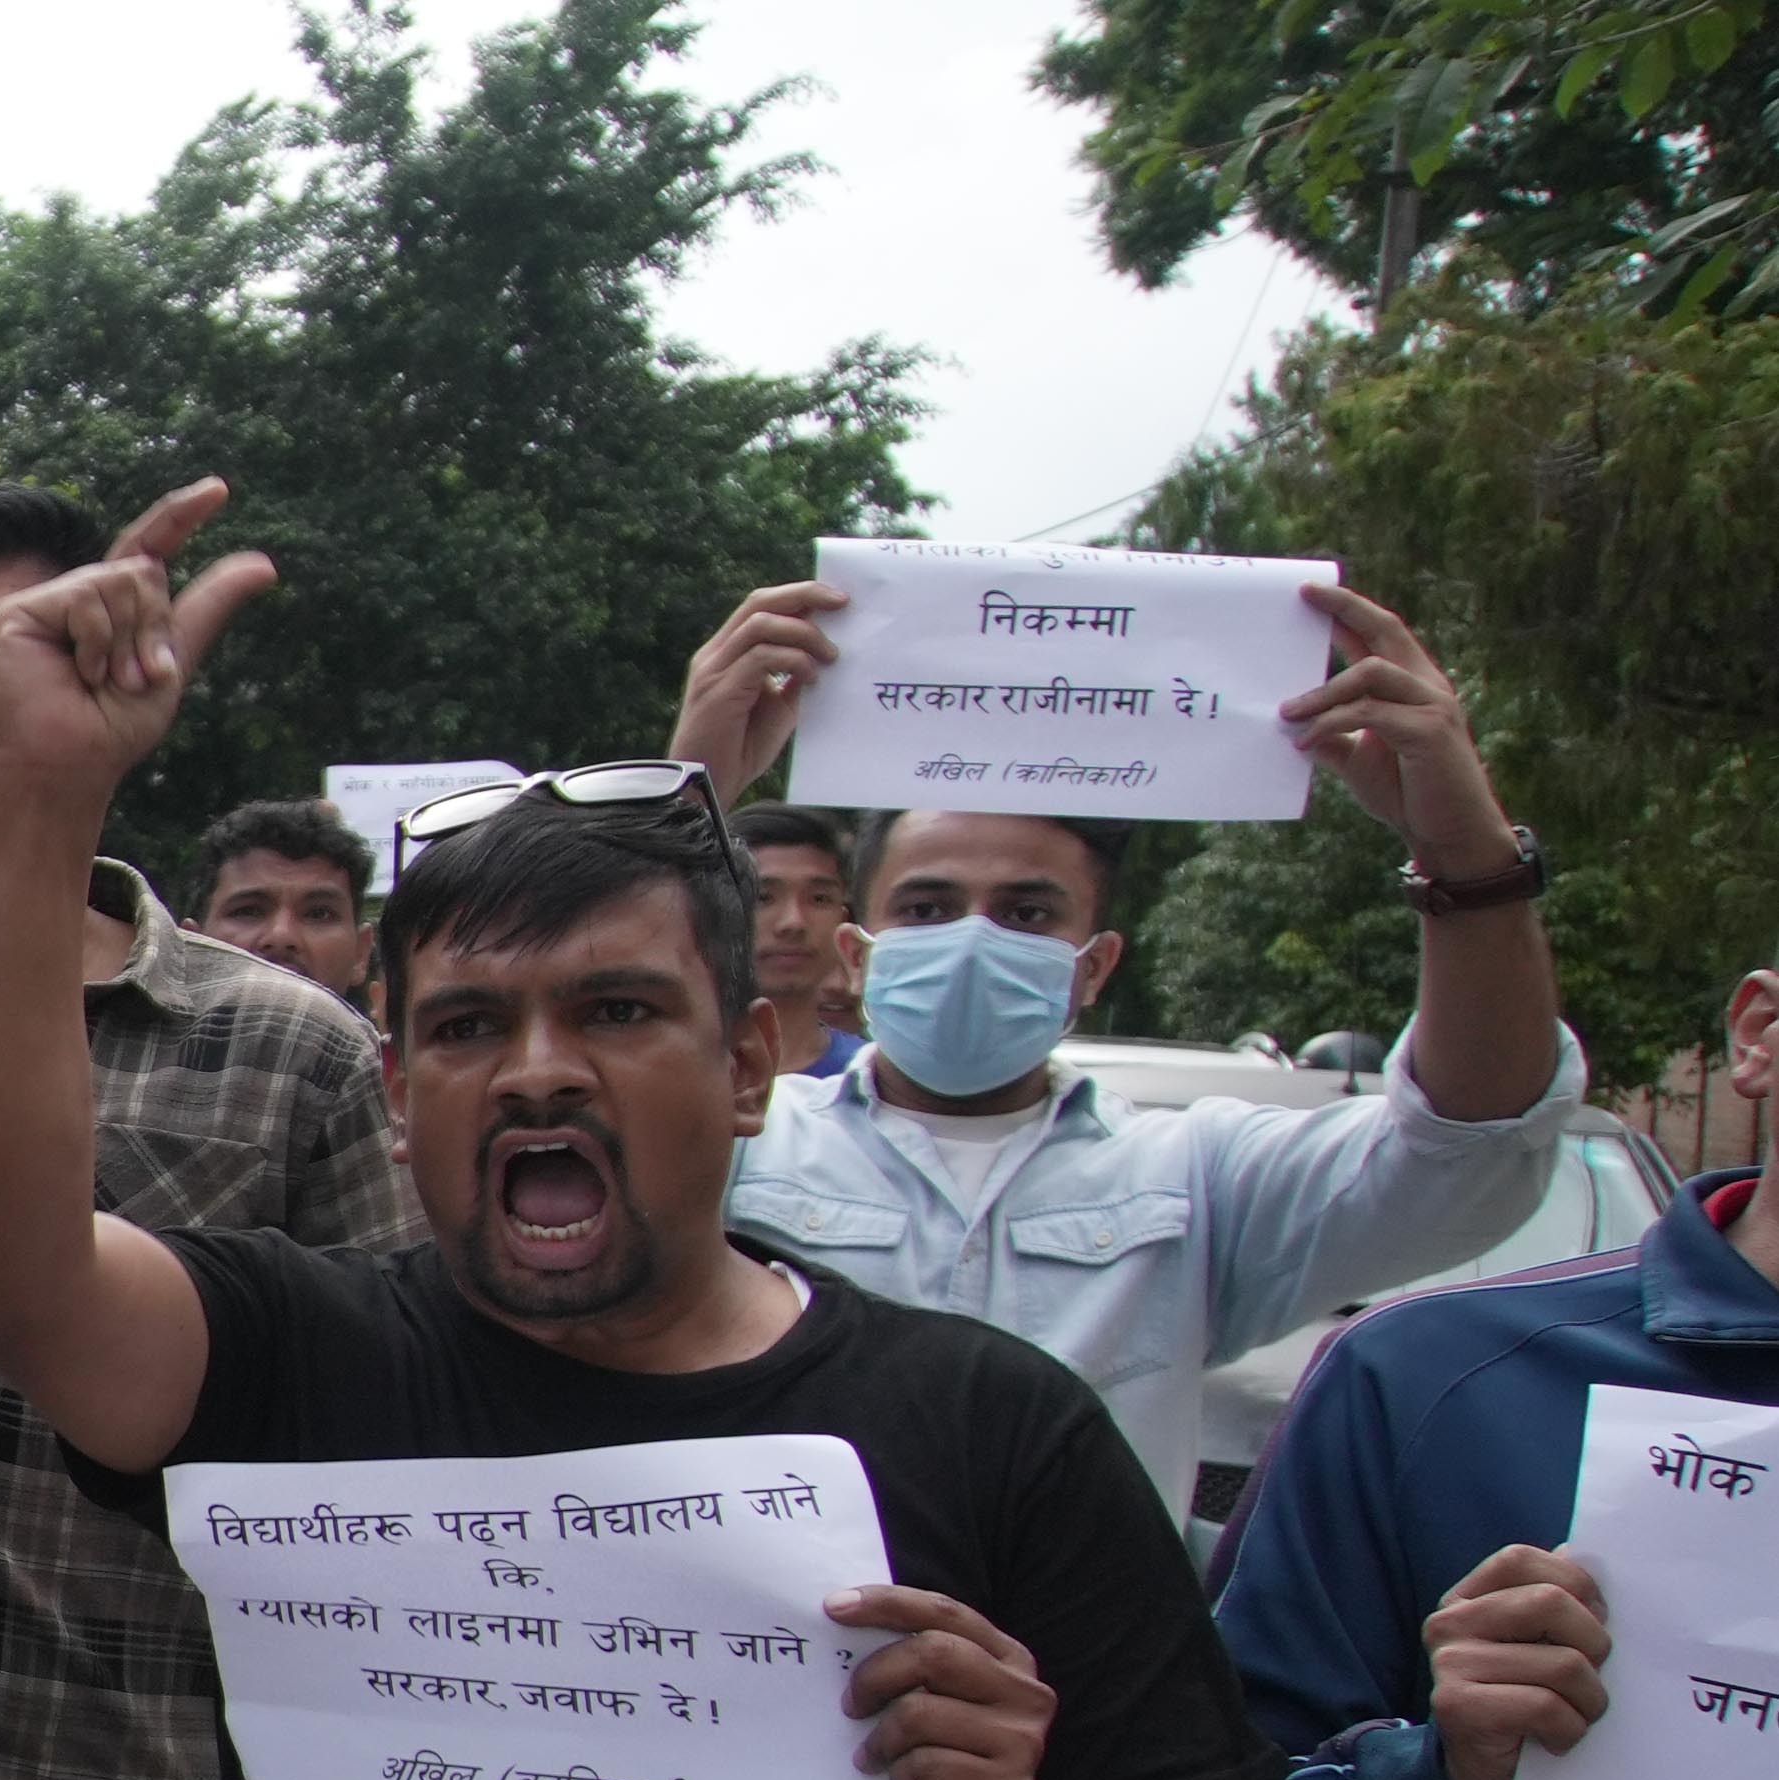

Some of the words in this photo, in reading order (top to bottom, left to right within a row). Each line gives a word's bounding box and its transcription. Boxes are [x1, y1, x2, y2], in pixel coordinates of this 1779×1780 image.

[980, 590, 1136, 636] निकम्मा
[873, 682, 994, 713] सरकार
[999, 676, 1155, 715] राजीनामा
[914, 754, 992, 782] अखिल
[1003, 757, 1158, 787] (क्रान्तिकारी)
[1649, 1433, 1768, 1499] भोक
[433, 1508, 529, 1549] पढ्न
[552, 1491, 723, 1541] विद्यालय
[741, 1474, 823, 1522] जाने
[402, 1607, 562, 1649] लाइनमा
[587, 1618, 699, 1660] उभिन
[720, 1628, 811, 1667] जाने
[511, 1679, 640, 1719] जवाफ
[1688, 1675, 1779, 1731] जन
